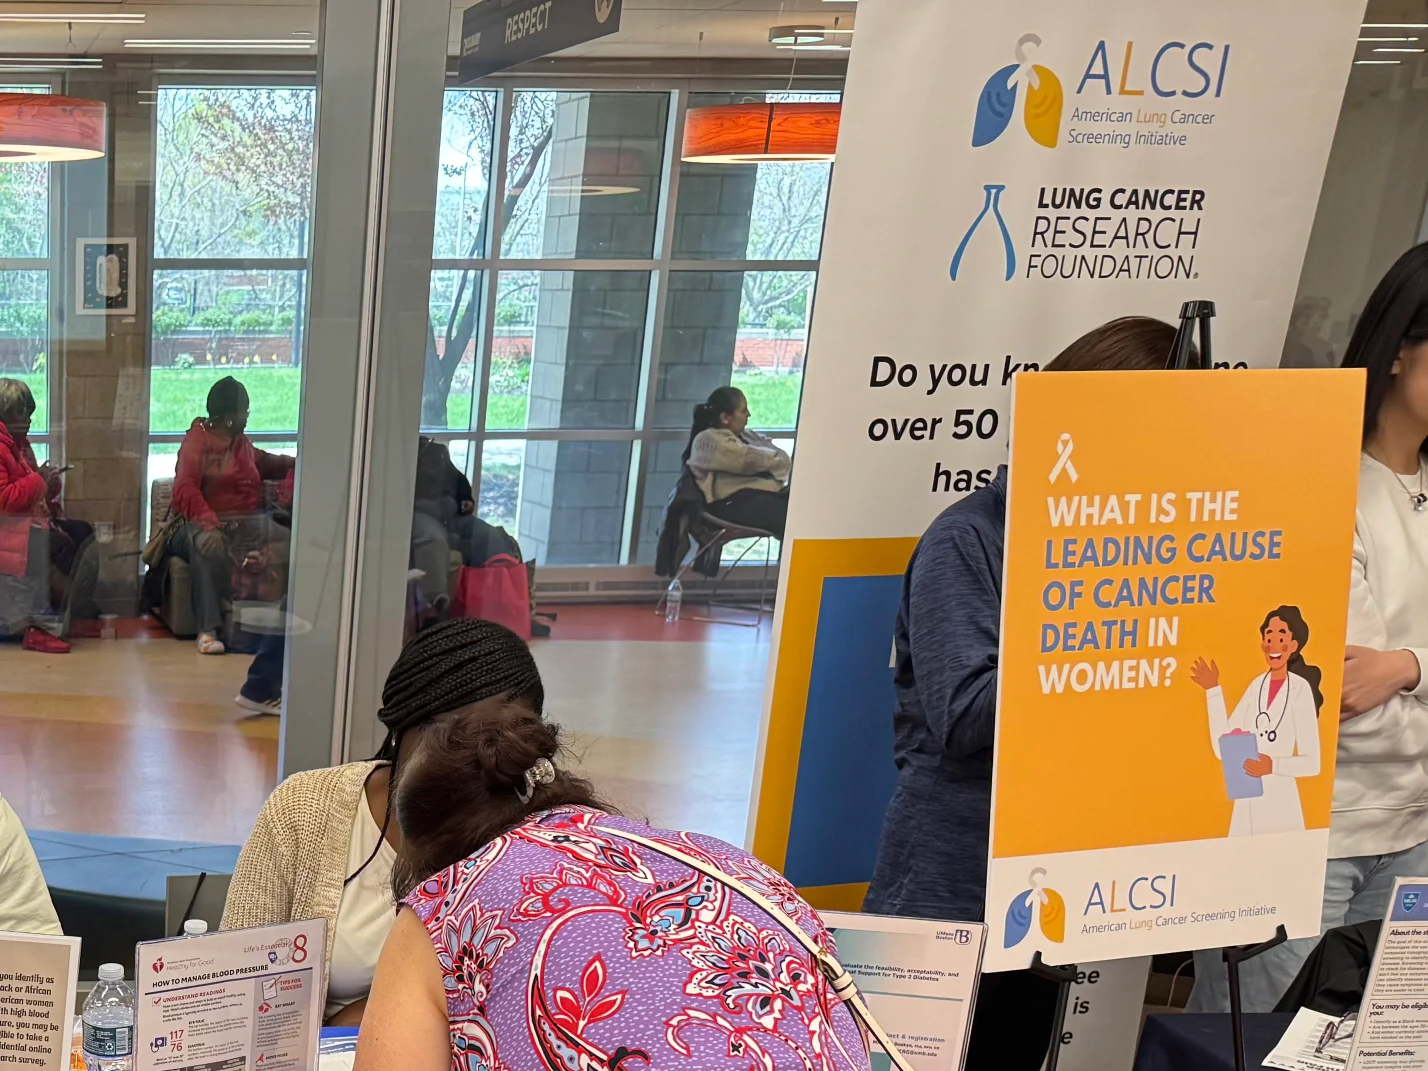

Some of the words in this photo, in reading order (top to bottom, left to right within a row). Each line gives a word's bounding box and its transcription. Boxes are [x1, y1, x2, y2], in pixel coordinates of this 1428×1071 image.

[505, 1, 552, 44] RESPECT
[1076, 40, 1230, 98] ALCSI
[1071, 107, 1132, 123] American
[1136, 109, 1167, 128] Lung
[1170, 109, 1215, 125] Cancer
[1068, 129, 1131, 148] Screening
[1135, 131, 1187, 146] Initiative
[1037, 187, 1103, 210] LUNG
[1109, 188, 1205, 211] CANCER
[1031, 216, 1201, 249] RESEARCH
[869, 355, 918, 387] Do
[926, 363, 990, 396] you
[868, 417, 943, 441] over
[952, 408, 999, 440] 50
[931, 462, 992, 492] has
[1046, 494, 1142, 527] WHAT
[1149, 492, 1177, 524] IS
[1186, 490, 1240, 522] THE
[1045, 534, 1177, 570] LEADING
[1186, 530, 1283, 562] CAUSE
[1042, 580, 1084, 612] OF
[1093, 573, 1216, 609] CANCER
[1040, 618, 1138, 653] DEATH
[1147, 616, 1179, 647] IN
[1038, 656, 1177, 695] WOMEN?
[1083, 874, 1176, 916] ALCSI
[1081, 922, 1127, 935] American
[1129, 918, 1153, 931] Lung
[1155, 914, 1187, 927] Cancer
[1190, 909, 1235, 923] Screening
[1238, 904, 1277, 918] Initiative
[1389, 929, 1410, 937] About
[292, 934, 307, 963] 8
[0, 973, 13, 982] you
[14, 972, 44, 984] identify
[45, 976, 55, 984] as
[152, 979, 170, 988] HOW
[171, 977, 181, 986] TO
[181, 973, 211, 984] MANAGE
[211, 969, 235, 979] BLOOD
[235, 964, 269, 976] PRESSURE
[857, 970, 881, 978] Support
[892, 972, 907, 980] Type
[875, 964, 905, 973] feasibility,
[907, 968, 946, 977] acceptability,
[1074, 969, 1100, 985] ee
[14, 985, 23, 993] or
[24, 984, 51, 995] African
[162, 993, 199, 1003] UNDERSTAND
[199, 988, 226, 997] READINGS
[25, 999, 54, 1007] women
[1072, 996, 1090, 1014] is
[10, 1008, 27, 1018] high
[28, 1009, 50, 1019] blood
[15, 1021, 30, 1030] you
[31, 1022, 49, 1031] may
[50, 1022, 59, 1031] be
[15, 1031, 24, 1040] to
[26, 1032, 43, 1041] take
[169, 1029, 184, 1040] 117
[28, 1045, 52, 1054] online
[170, 1042, 183, 1053] 76
[18, 1057, 46, 1067] survey.
